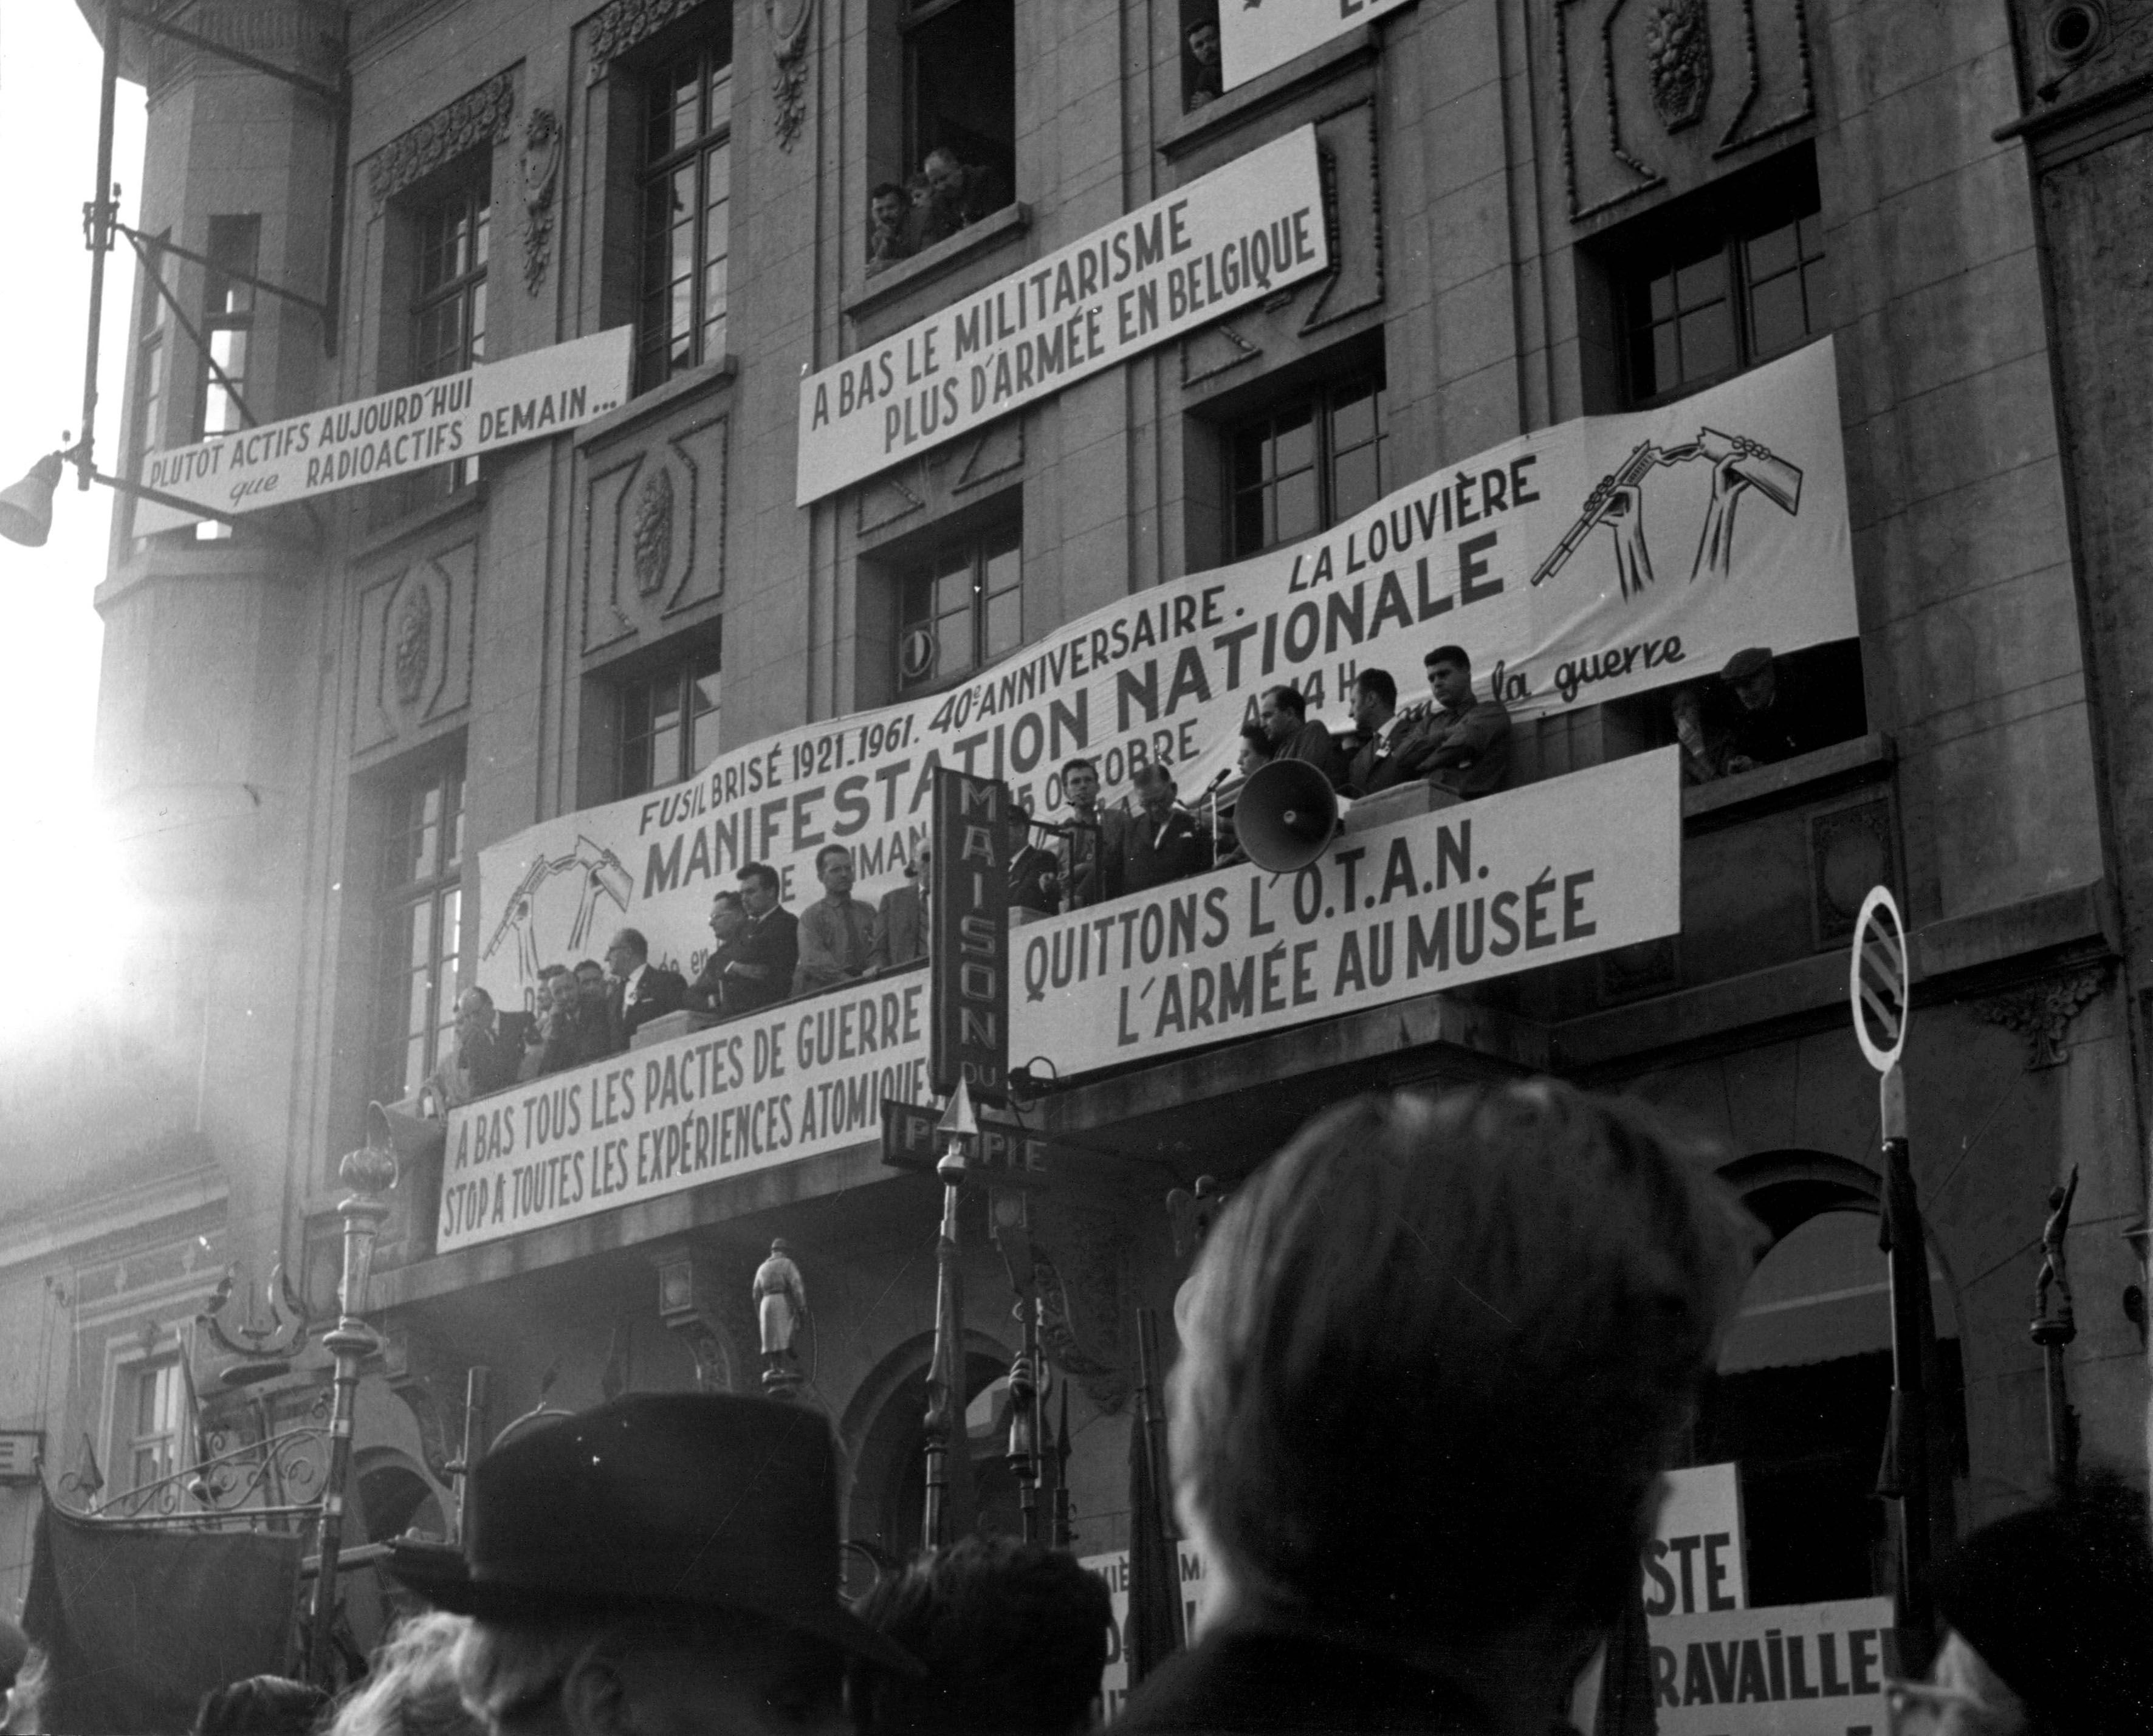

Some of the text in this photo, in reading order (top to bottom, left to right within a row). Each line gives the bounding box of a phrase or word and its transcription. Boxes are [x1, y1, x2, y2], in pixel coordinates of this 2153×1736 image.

[812, 198, 1192, 431] A BAS LE MILITARISME
[885, 206, 1316, 454] PLUS D'ARMÉE EN BELGIQUE
[150, 377, 473, 489] PLUTOT ACTIFS AUJOURD'HUI
[229, 385, 617, 507] que RADIOACTIFS DEMAIN...
[639, 782, 706, 836] FUSIL
[711, 742, 782, 809] BRISÉ
[1289, 546, 1333, 594] LA
[1347, 455, 1540, 575] LOUVIÈRE
[643, 530, 1505, 900] MANIFESTATION NATIONALE
[1492, 636, 1686, 703] la guerre
[1045, 718, 1200, 812] OOBRE
[960, 777, 998, 1050] MAISON
[1024, 883, 1229, 1002] QUITTONS
[1117, 865, 1596, 1046] L'ARMÉE AU MUSÉE
[456, 984, 922, 1170] A BAS TOUS LES PACTES DE GUERRE
[961, 1062, 996, 1087] DU
[444, 1165, 490, 1237] STOP
[492, 1173, 505, 1223] A
[513, 1151, 585, 1220] TOUTES
[591, 1138, 628, 1199] LES
[637, 1094, 793, 1186] EXPÉRIENCES
[1650, 1628, 1893, 1709] RAVAILLE
